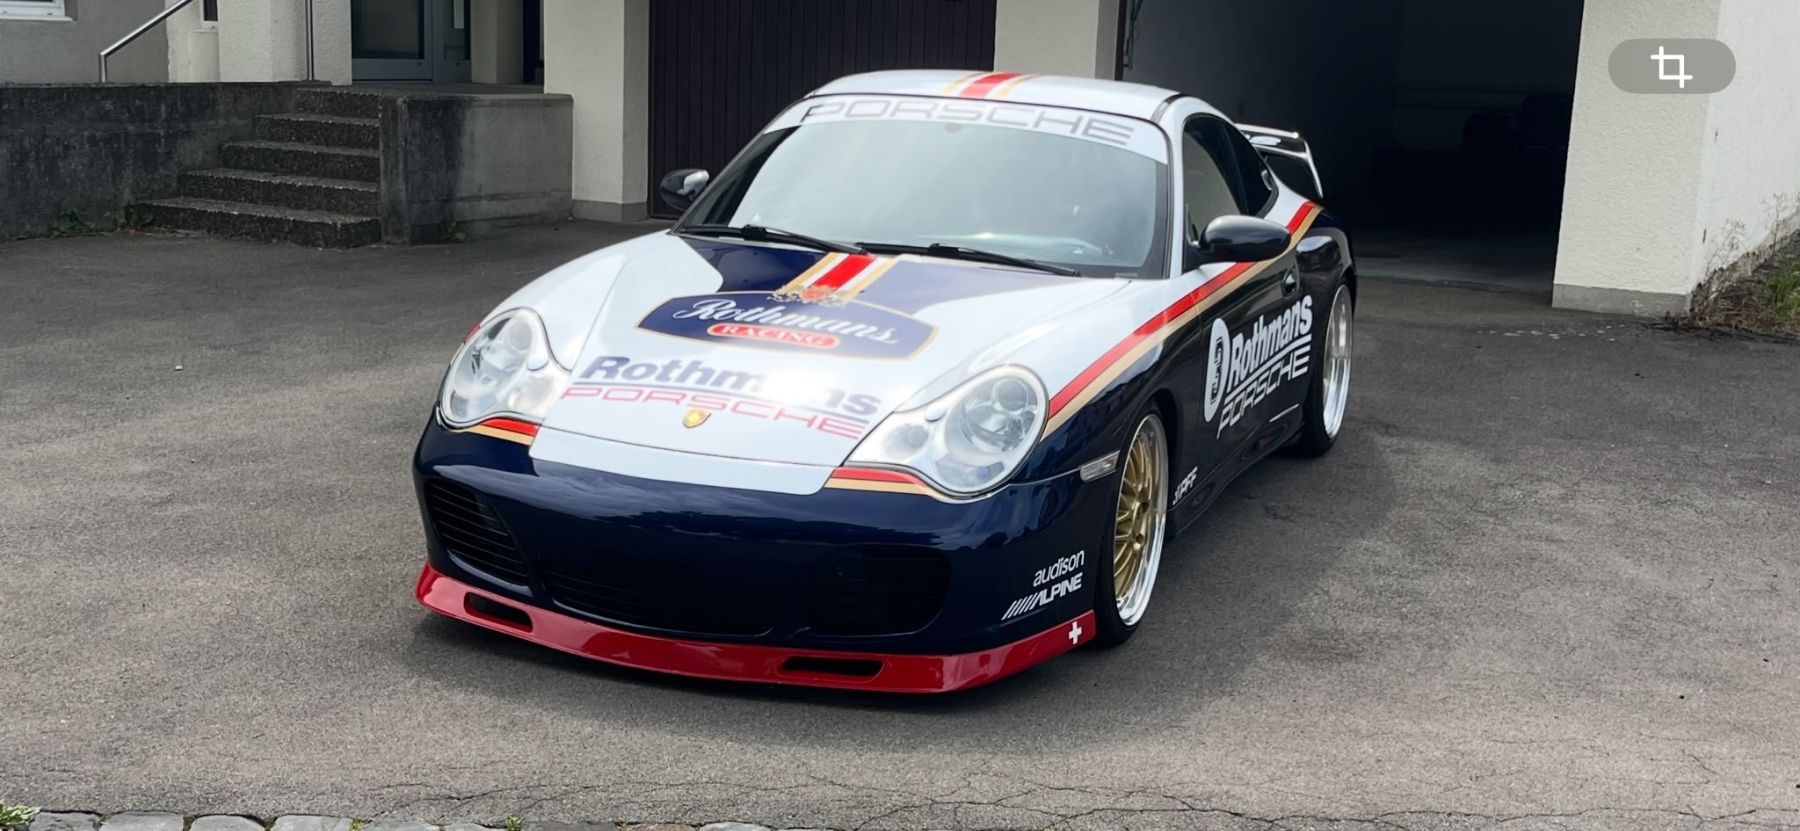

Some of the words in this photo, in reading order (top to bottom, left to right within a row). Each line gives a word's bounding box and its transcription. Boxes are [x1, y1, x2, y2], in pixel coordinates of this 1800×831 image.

[800, 100, 1134, 146] PORSCHE
[672, 299, 898, 344] Rothmans
[720, 325, 829, 347] RACING
[1226, 295, 1313, 394] Rothmans
[578, 356, 882, 418] Rothmns
[1216, 344, 1312, 440] PORSCHE
[560, 387, 867, 440] PORSCHE
[1032, 550, 1085, 588] audison
